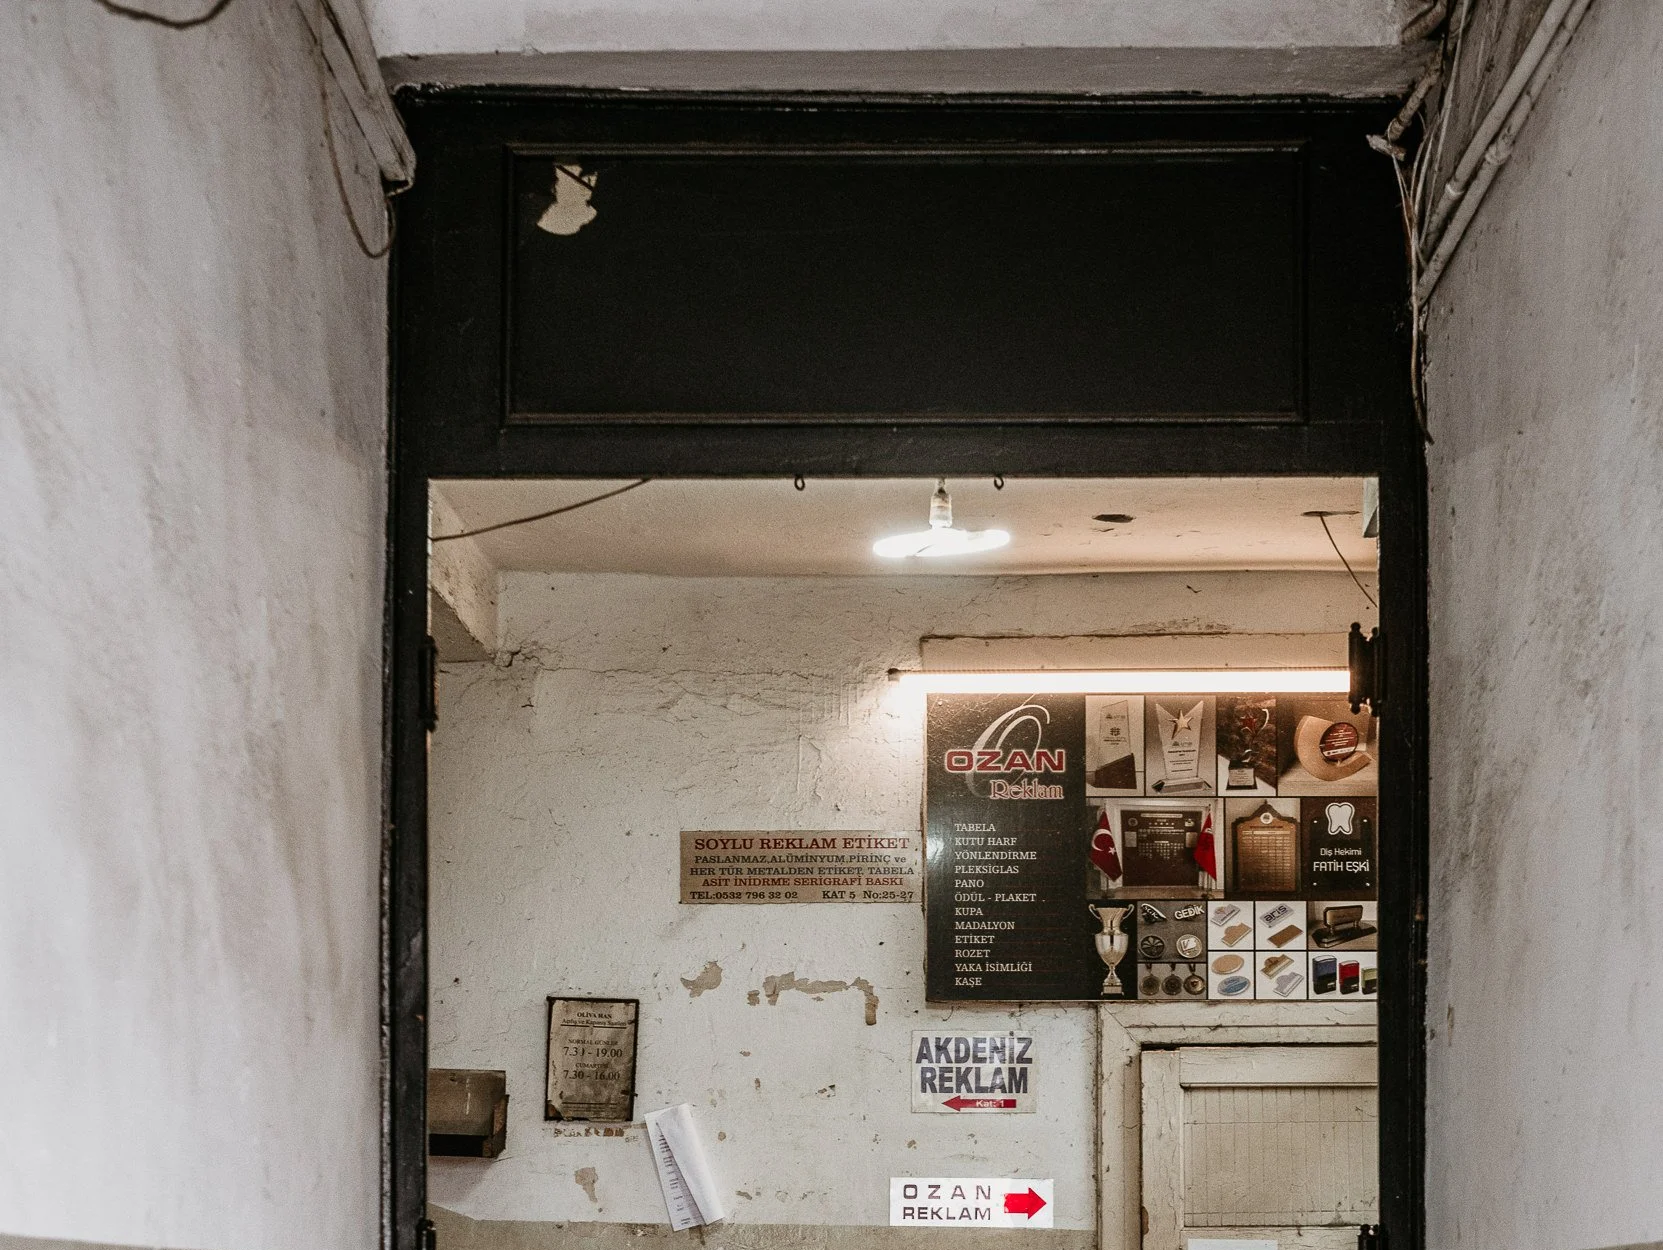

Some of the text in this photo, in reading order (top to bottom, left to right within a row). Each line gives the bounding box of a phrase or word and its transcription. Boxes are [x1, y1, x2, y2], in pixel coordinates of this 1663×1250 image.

[945, 749, 1066, 773] OZAN
[990, 778, 1064, 799] Reklam
[954, 823, 996, 832] TABELA
[694, 834, 909, 850] SOYLU REKLAM ETİKET
[954, 837, 1017, 846] KUTU HARF
[954, 849, 1037, 860] YÖNLENDİRME
[1320, 848, 1362, 856] Diş Hekimi
[690, 867, 716, 876] HER
[718, 865, 743, 876] TÜR
[747, 867, 814, 876] METALDEN
[868, 866, 914, 876] TABELA
[954, 863, 1019, 874] PLEKSİGLAS
[1313, 859, 1370, 873] FATİH EŞKİ
[702, 875, 903, 887] ASİT İNİDRME SERİGRAFİ BASKI
[954, 879, 984, 888] PANO
[690, 890, 914, 900] TEL:0532 796 32 02 KAT 5 No:25-27
[954, 892, 985, 902] ÖDÜL
[995, 893, 1037, 902] PLAKET
[954, 907, 983, 916] KUPA
[954, 921, 1015, 930] MADALYON
[954, 934, 995, 944] ETİKET
[954, 949, 990, 958] ROZET
[954, 963, 983, 972] YAKA
[954, 977, 982, 988] KAŞE
[596, 1048, 622, 1057] 19.00
[916, 1031, 1033, 1064] AKDENİZ
[563, 1070, 584, 1079] 7.30
[595, 1071, 620, 1080] 16.00
[921, 1067, 1028, 1094] REKLAM
[903, 1207, 991, 1220] REKLAM
